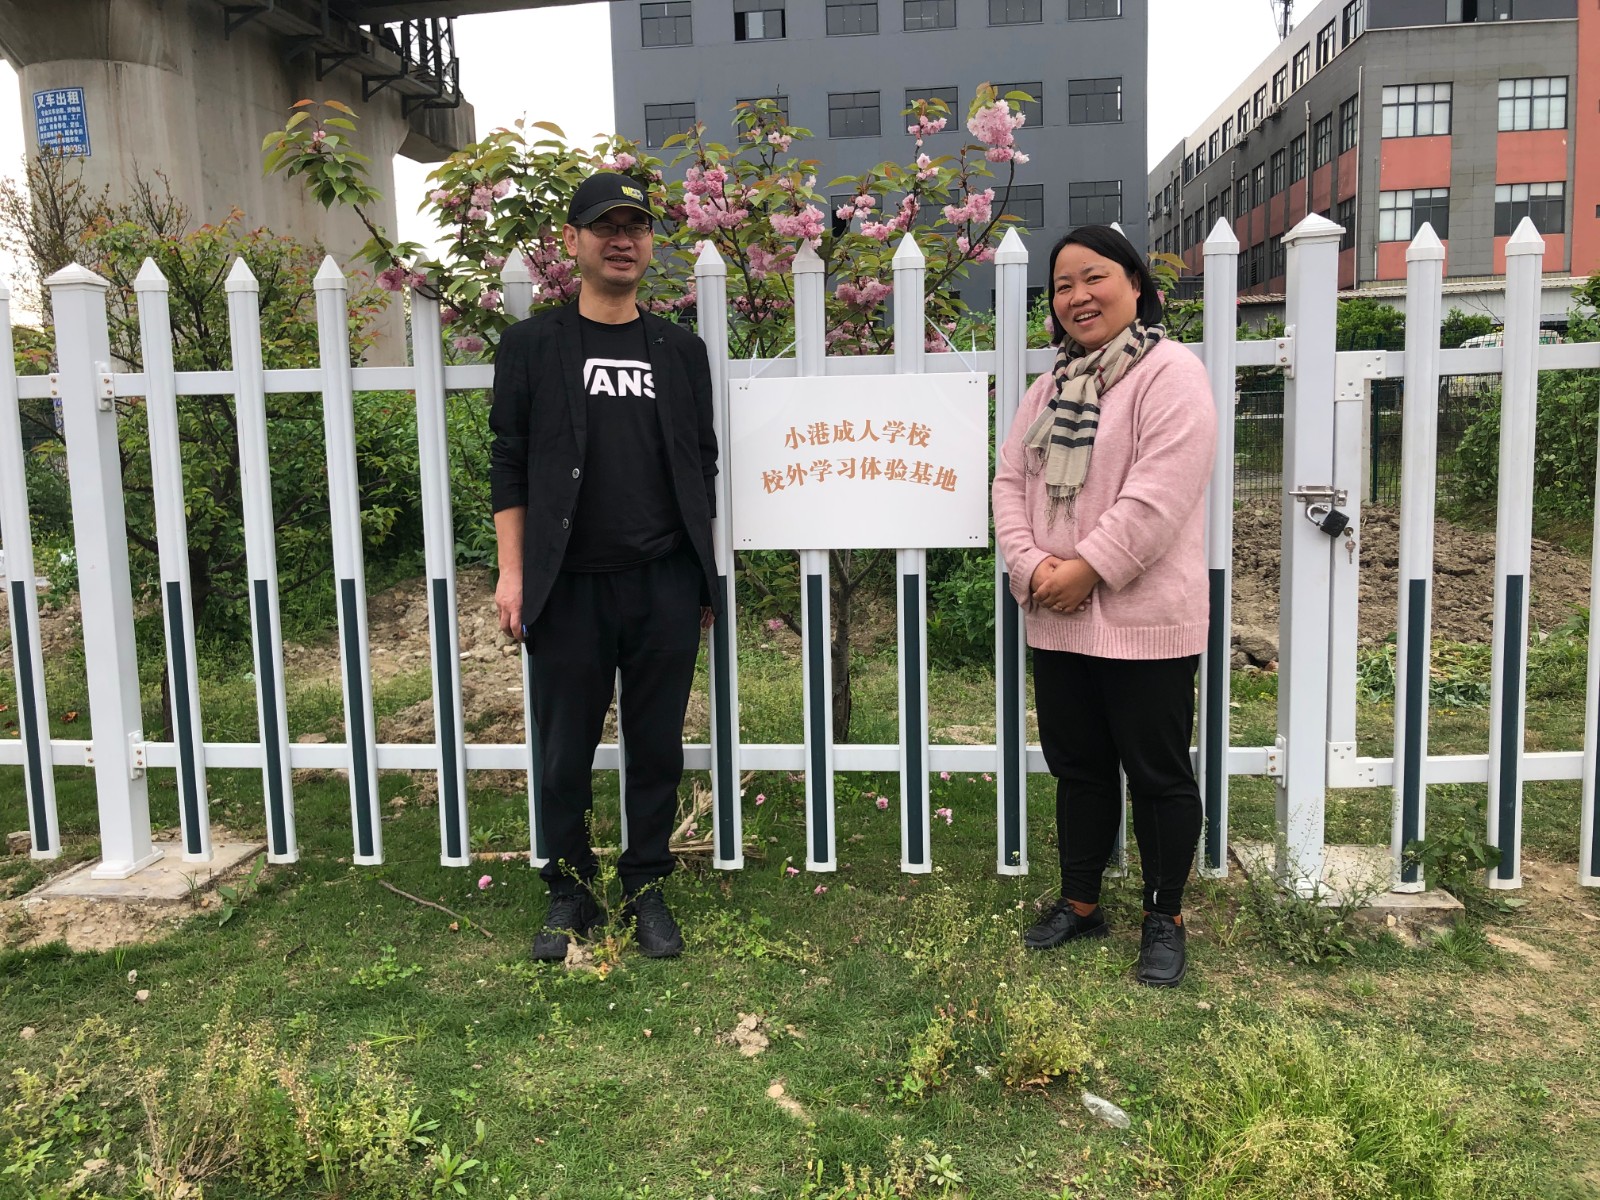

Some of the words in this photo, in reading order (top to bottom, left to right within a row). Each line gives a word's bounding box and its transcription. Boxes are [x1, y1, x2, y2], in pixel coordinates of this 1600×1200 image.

[37, 91, 79, 109] 叉车出租
[784, 419, 932, 450] 小港成人学校
[761, 456, 958, 495] 校外学习体验基地
